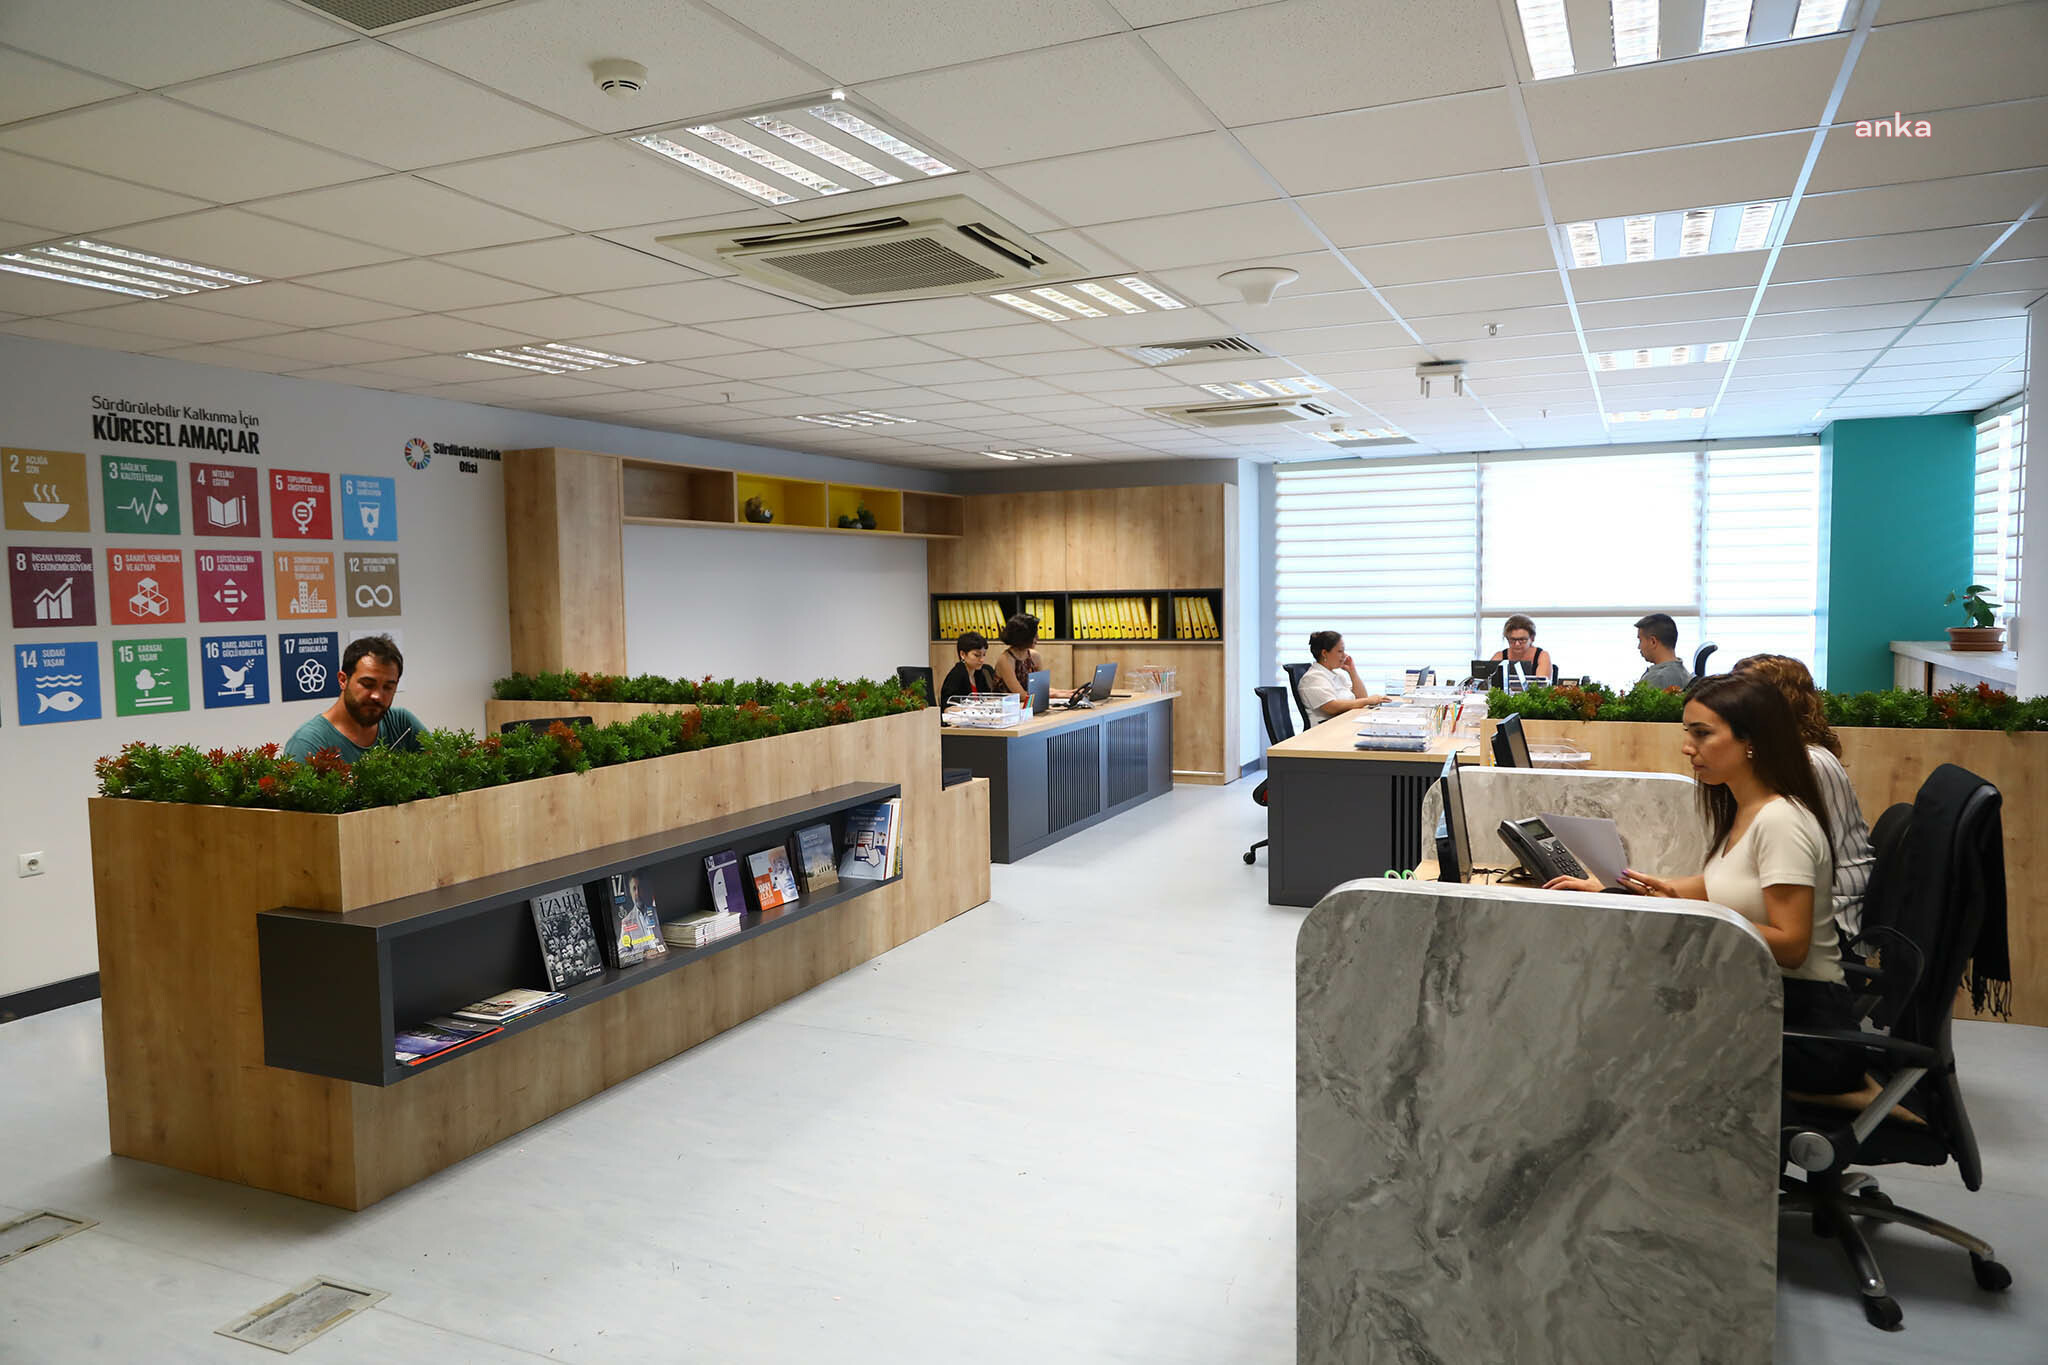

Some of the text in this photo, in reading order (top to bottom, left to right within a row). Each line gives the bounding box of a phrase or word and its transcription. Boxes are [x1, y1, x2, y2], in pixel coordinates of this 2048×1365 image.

[91, 395, 260, 429] Sürdürülebilir Kalkınma İçin
[92, 412, 260, 454] KÜRESEL AMAÇLAR
[433, 442, 502, 461] Sürdürülebilirlik
[10, 454, 20, 473] 2
[109, 462, 118, 479] 3
[459, 461, 478, 473] Ofisi
[197, 469, 206, 486] 4
[275, 475, 283, 490] 5
[345, 479, 353, 495] 6
[16, 553, 27, 571] 8
[113, 554, 123, 572] 9
[200, 555, 214, 571] 10
[278, 556, 289, 572] 11
[349, 557, 360, 573] 12
[119, 645, 133, 662] 15
[205, 642, 219, 658] 16
[284, 639, 295, 654] 17
[21, 650, 38, 668] 14
[539, 891, 584, 918] İZMİR
